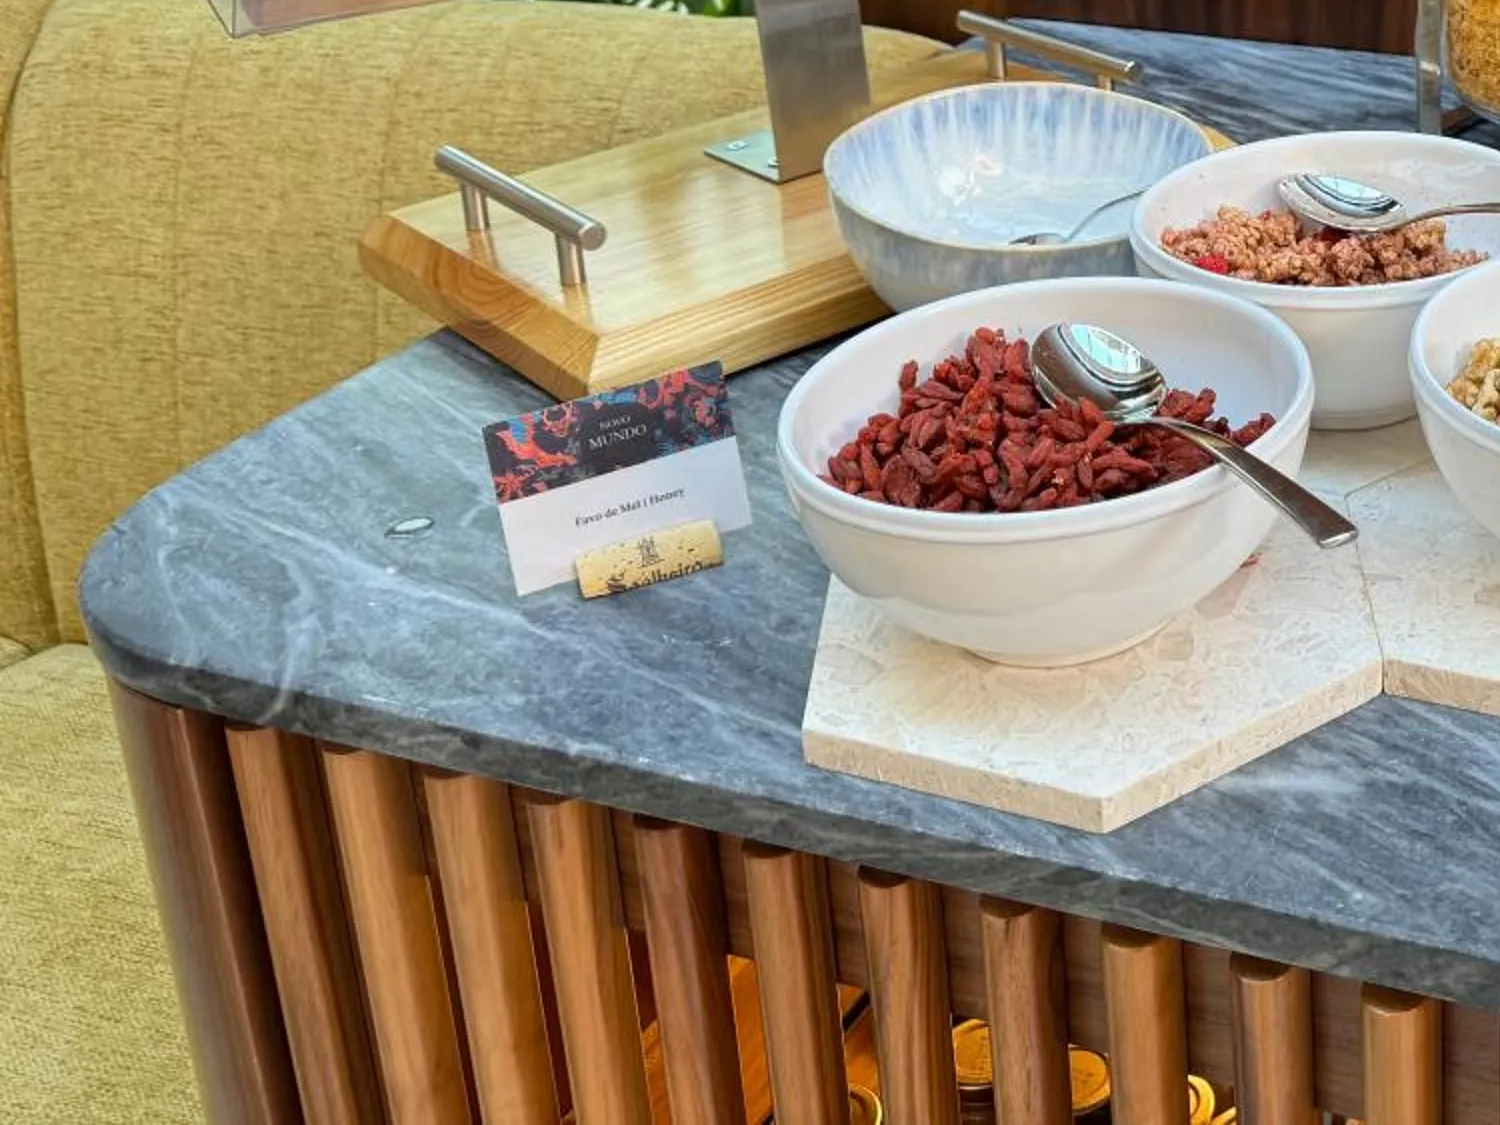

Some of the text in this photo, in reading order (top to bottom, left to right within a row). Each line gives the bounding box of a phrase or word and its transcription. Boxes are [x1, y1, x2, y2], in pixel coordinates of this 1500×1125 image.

[599, 414, 632, 430] NOVO
[587, 424, 648, 450] MUNDO
[605, 506, 619, 519] de
[620, 499, 642, 516] Mel
[649, 487, 686, 507] Honey
